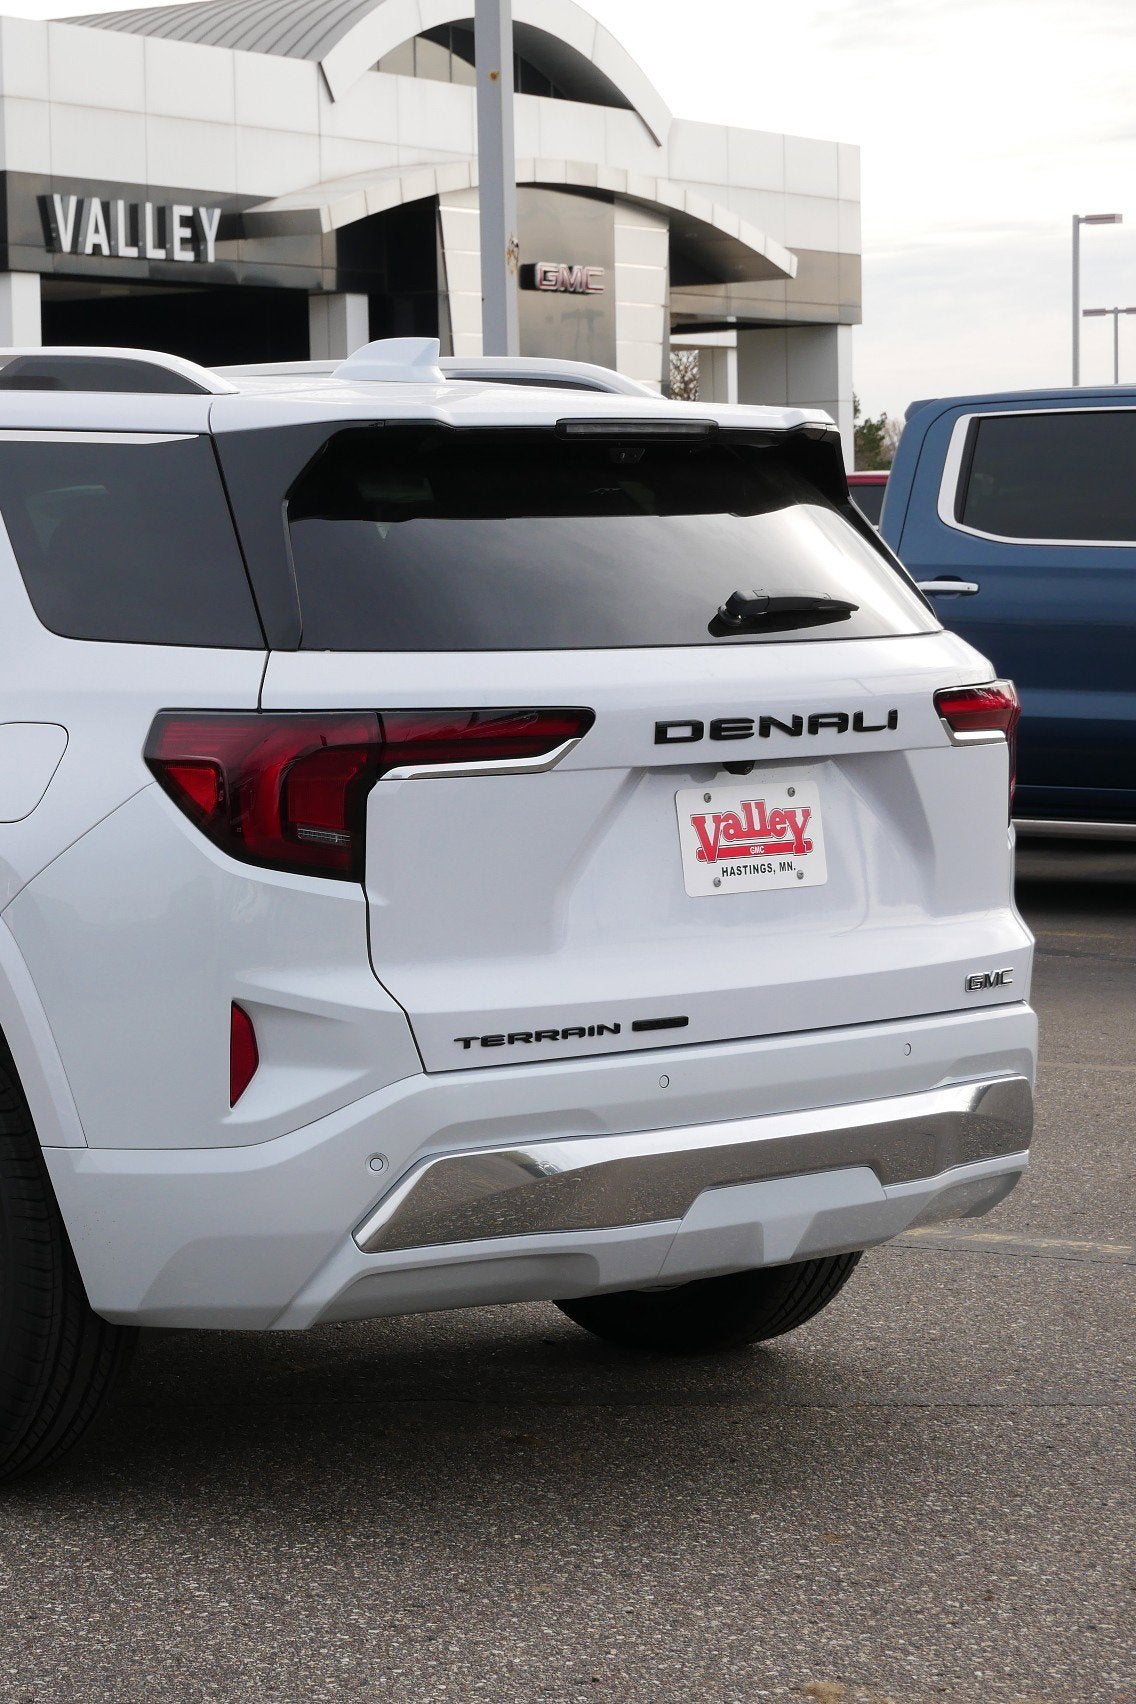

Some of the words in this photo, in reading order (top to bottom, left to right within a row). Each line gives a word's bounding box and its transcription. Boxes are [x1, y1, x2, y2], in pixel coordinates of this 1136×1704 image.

[52, 193, 223, 263] VALLEY
[537, 261, 604, 294] GMC
[654, 708, 898, 745] DENALI
[690, 799, 812, 864] Valley
[749, 845, 765, 855] GMC
[721, 863, 776, 878] HASTINGS,
[779, 861, 797, 873] MN.
[965, 967, 1013, 992] GMC
[453, 1022, 621, 1050] TERRAIN
